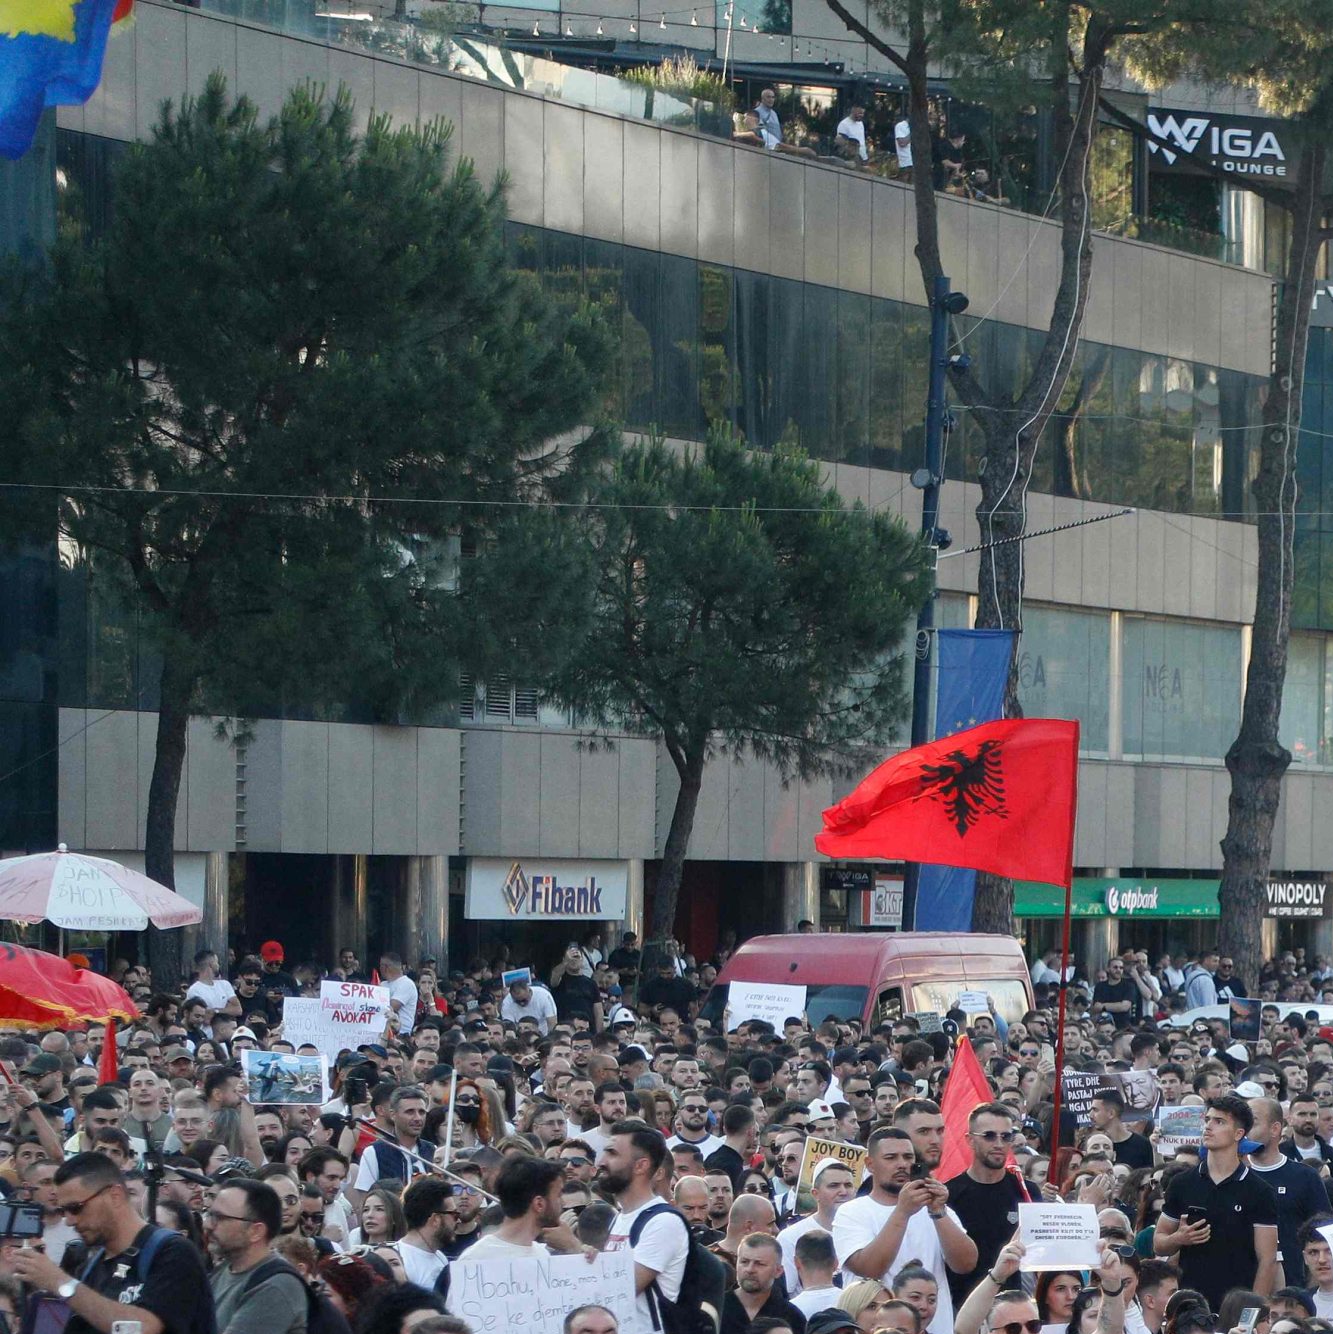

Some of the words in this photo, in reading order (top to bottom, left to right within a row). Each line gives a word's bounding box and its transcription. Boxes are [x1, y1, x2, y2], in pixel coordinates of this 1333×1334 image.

[1211, 160, 1287, 176] OUNGE
[529, 876, 602, 913] Fibank
[1120, 886, 1159, 915] otpbank
[1266, 883, 1327, 905] VINOPOLY
[340, 983, 375, 999] SPAK
[331, 1009, 376, 1025] AVOKAT
[1085, 1076, 1100, 1087] DHE
[1067, 1089, 1093, 1100] PASTAJ
[811, 1141, 836, 1156] JOY
[838, 1147, 863, 1162] BOY
[462, 1262, 534, 1300] Mbahu,
[462, 1301, 497, 1333] Se
[505, 1301, 527, 1327] ke
